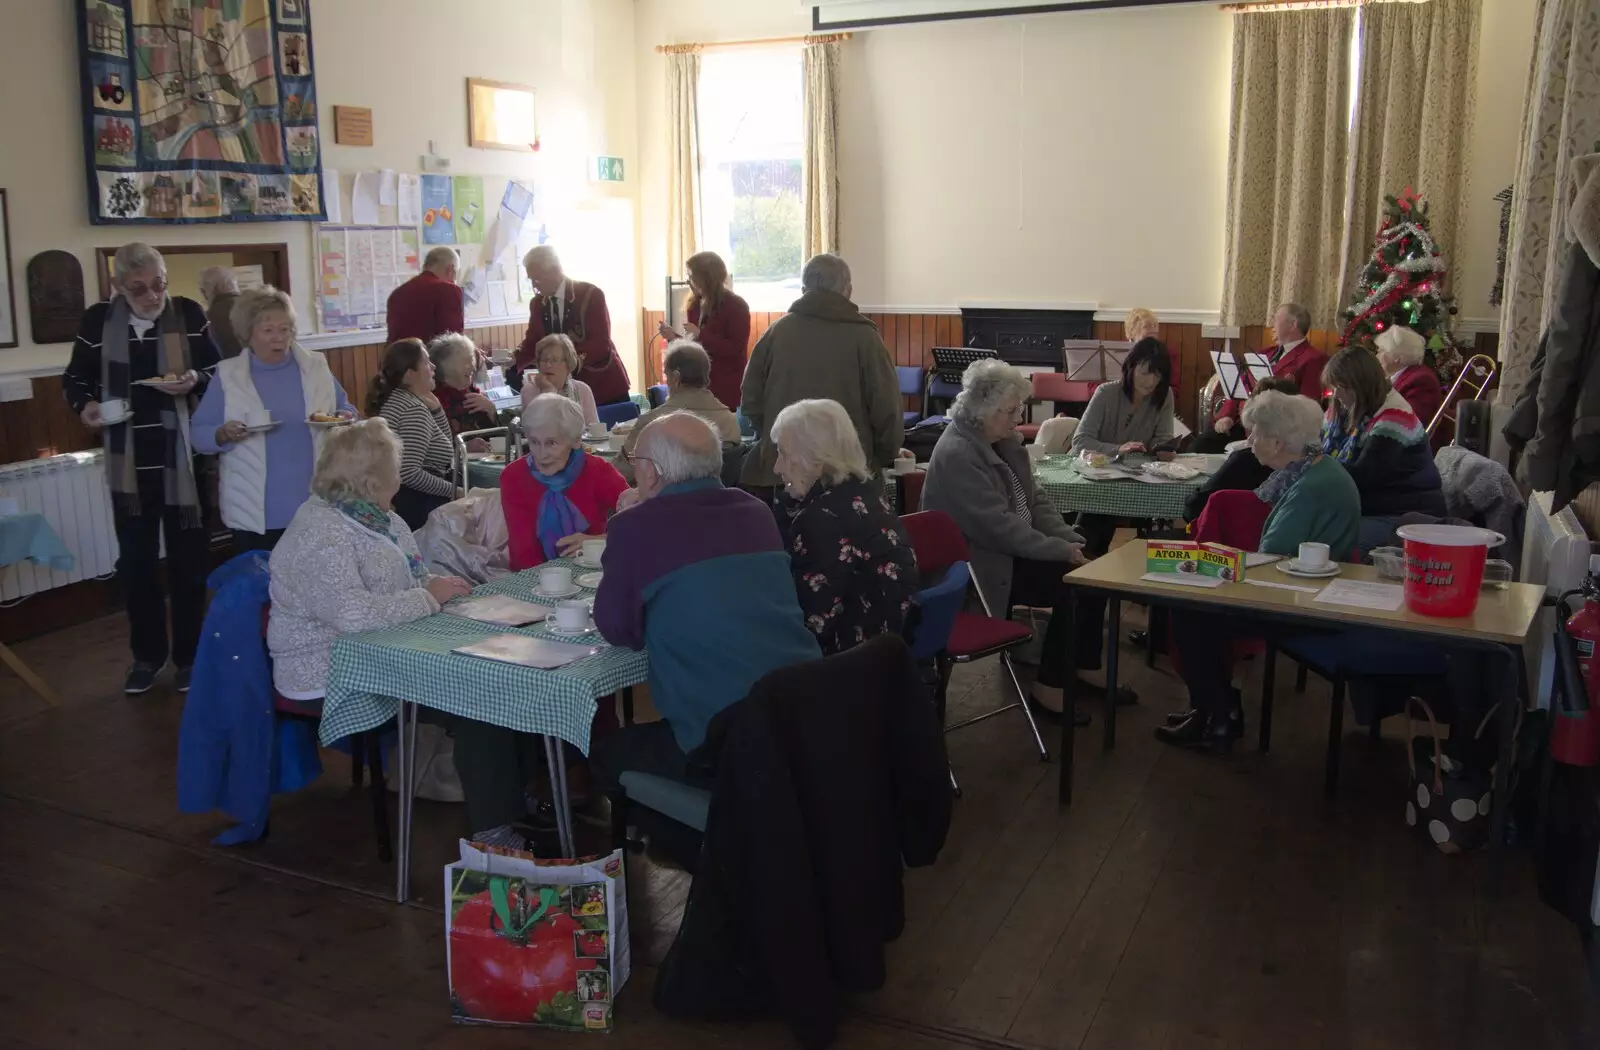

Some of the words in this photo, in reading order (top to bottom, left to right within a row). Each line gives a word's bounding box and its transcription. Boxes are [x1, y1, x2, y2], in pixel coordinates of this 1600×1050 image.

[1155, 550, 1191, 559] ATORA
[1202, 552, 1228, 565] ATORA
[1425, 573, 1453, 585] Band
